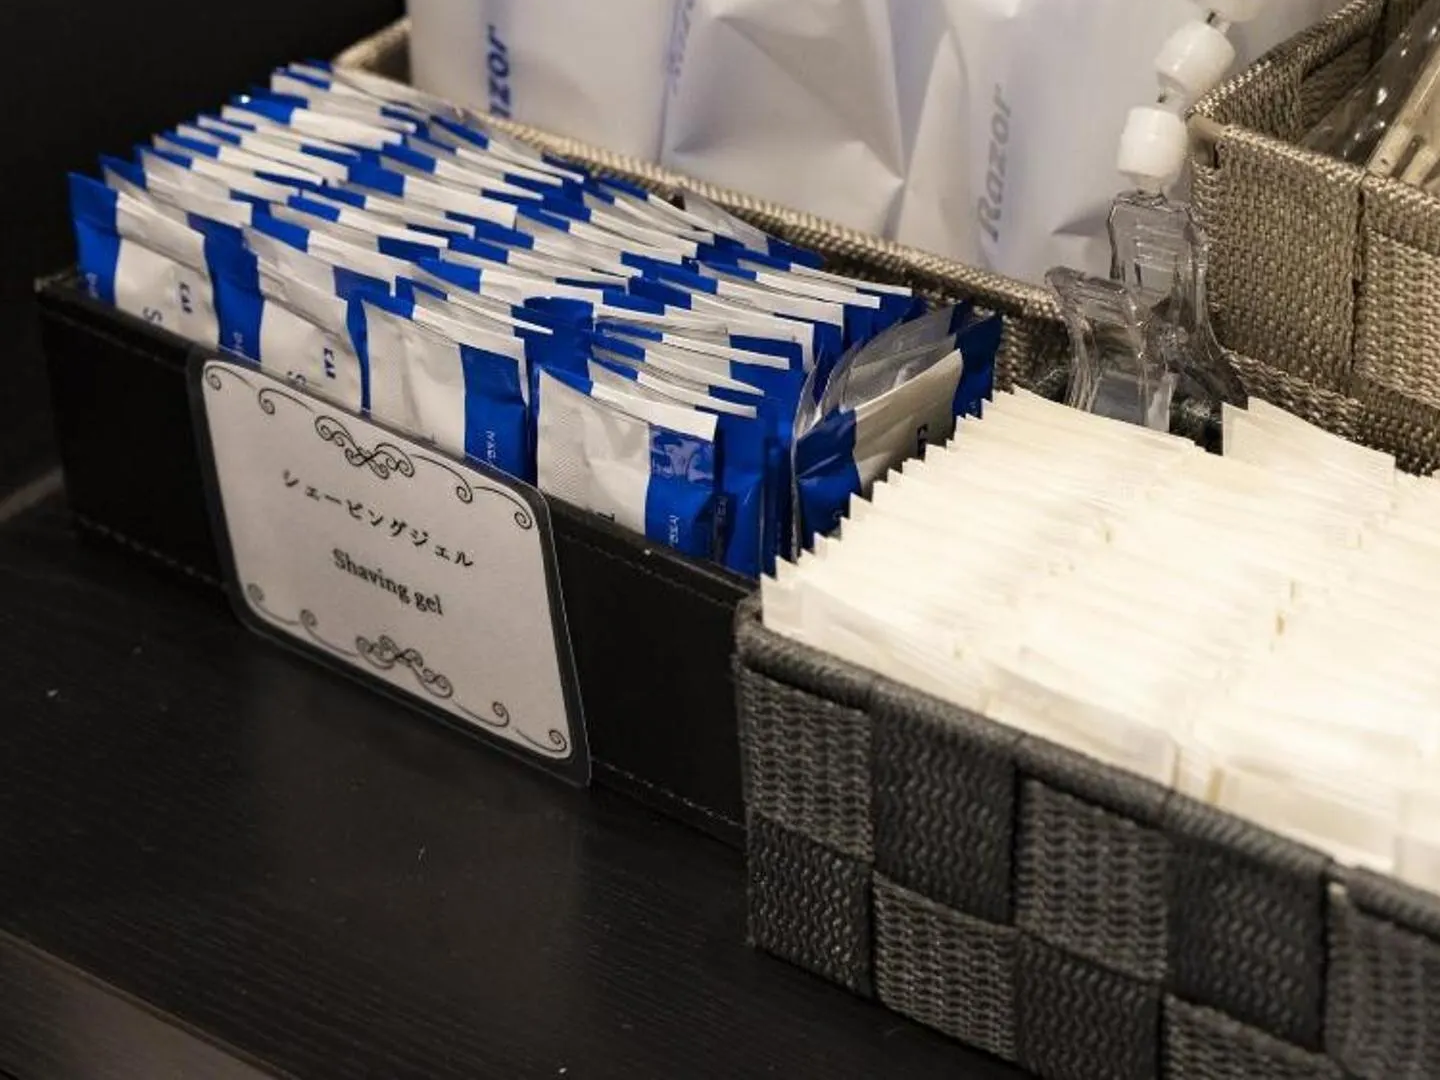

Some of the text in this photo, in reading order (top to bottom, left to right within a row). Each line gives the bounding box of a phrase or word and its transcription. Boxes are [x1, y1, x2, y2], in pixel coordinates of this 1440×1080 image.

[976, 82, 1012, 243] Razor
[332, 547, 444, 617] Shaving gel
